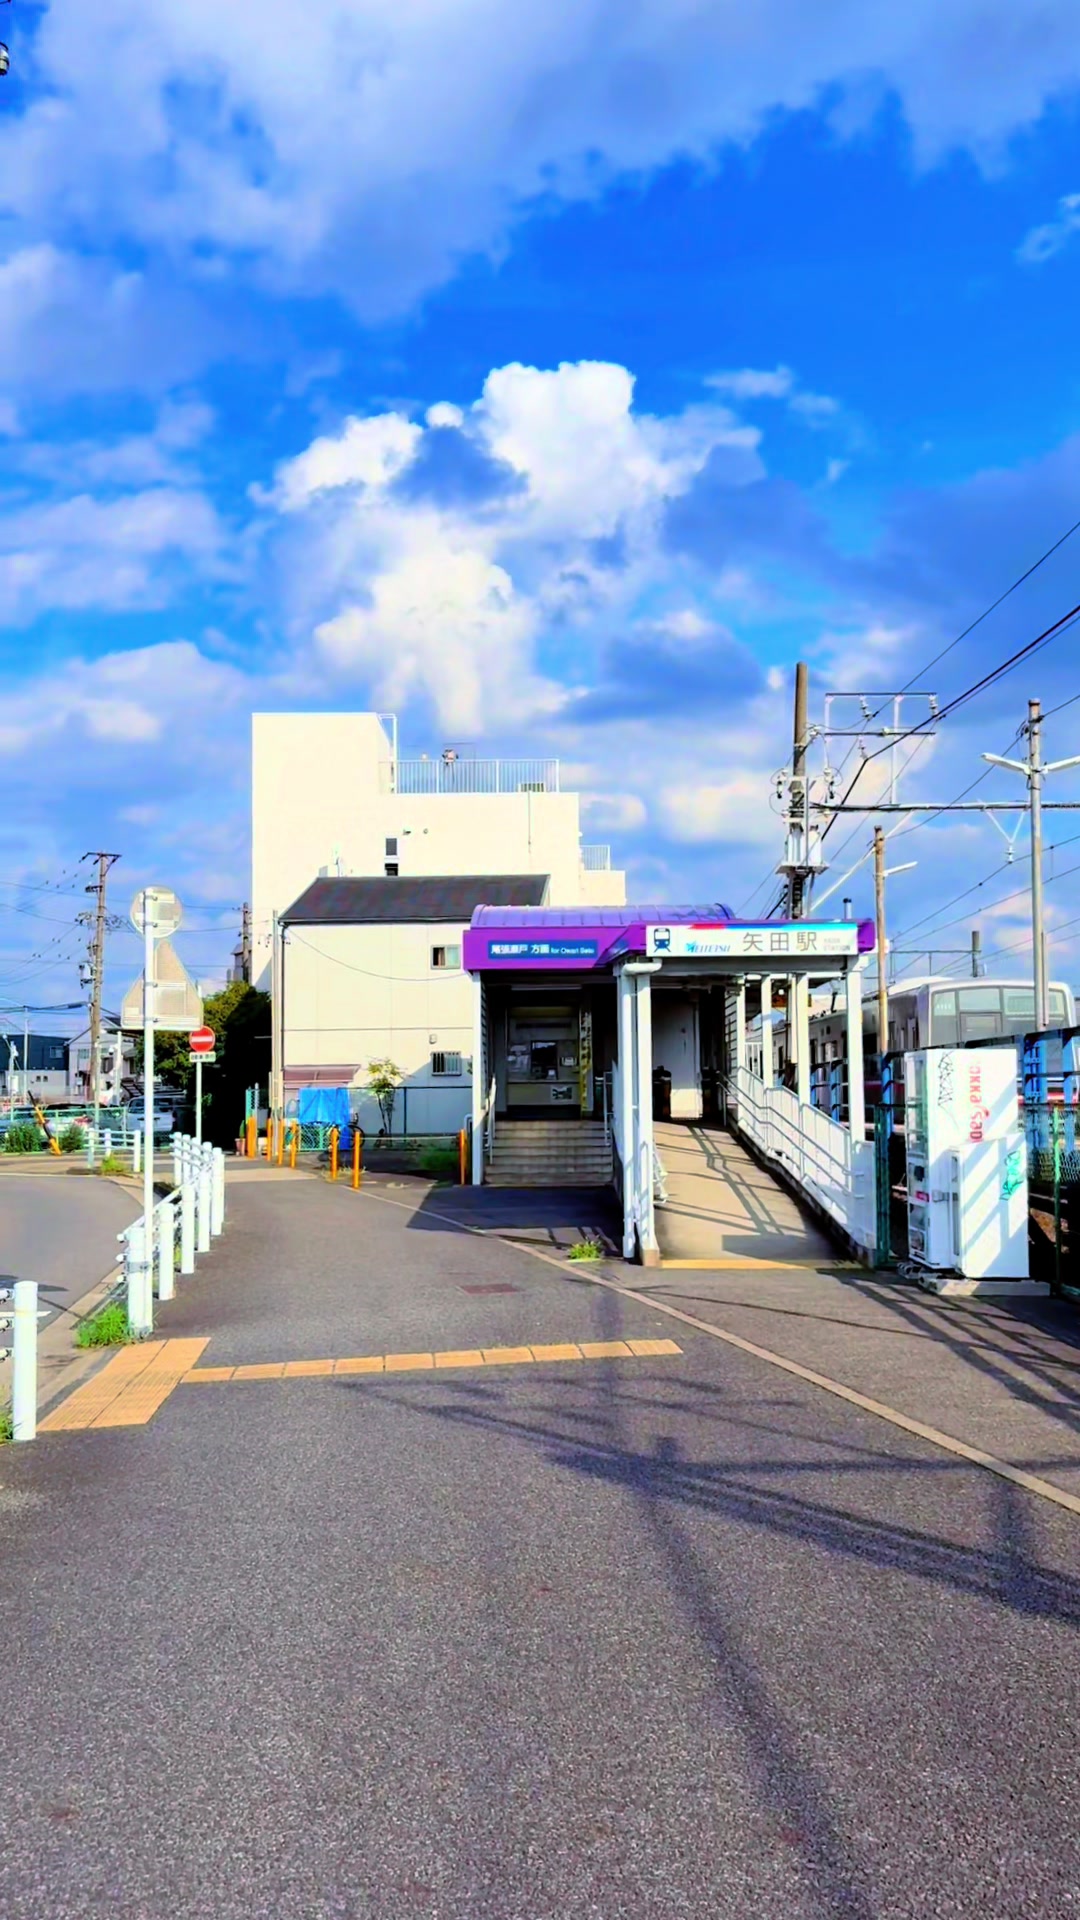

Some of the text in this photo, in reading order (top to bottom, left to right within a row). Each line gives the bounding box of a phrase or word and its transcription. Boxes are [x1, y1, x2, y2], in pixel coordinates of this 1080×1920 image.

[686, 941, 731, 953] MEITETSU
[743, 932, 817, 951] 矢田駅
[531, 944, 550, 954] 方面
